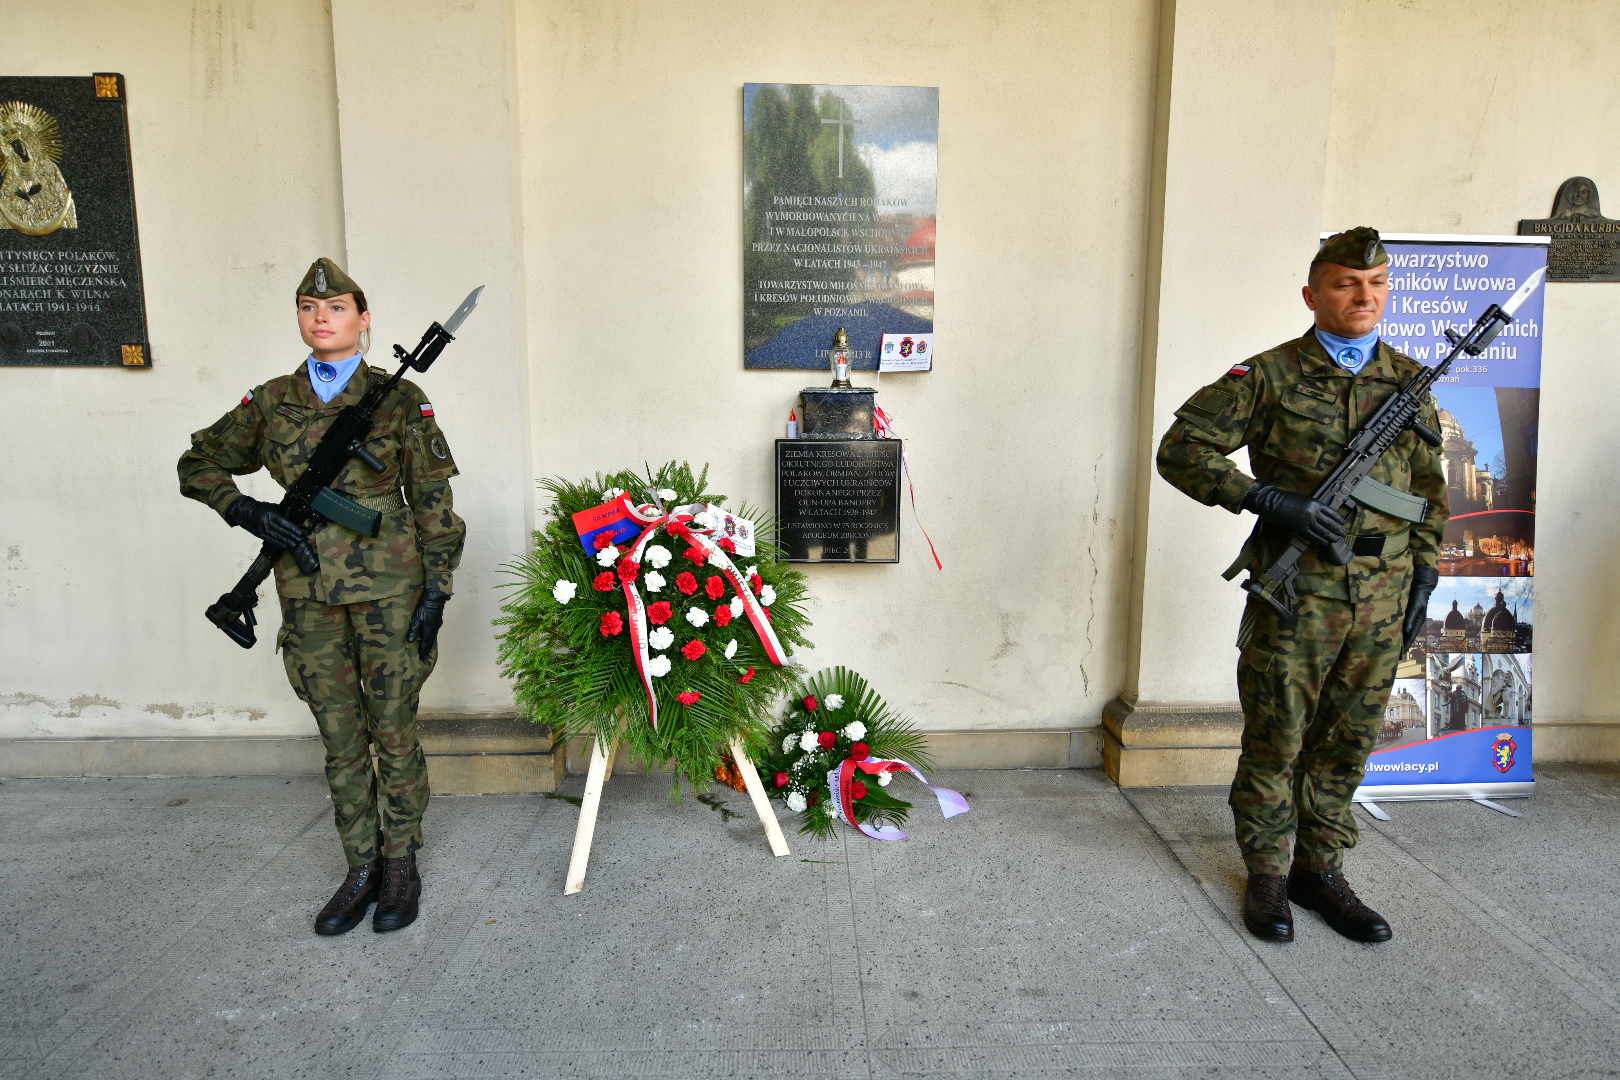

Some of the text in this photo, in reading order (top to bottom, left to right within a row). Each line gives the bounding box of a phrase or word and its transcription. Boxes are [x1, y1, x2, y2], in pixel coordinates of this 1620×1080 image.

[773, 196, 813, 208] PAMIĘCI
[814, 196, 858, 207] NASZYCH
[766, 211, 856, 222] WYMORDOWANYCH
[859, 212, 872, 222] NA
[775, 228, 785, 236] W
[786, 228, 850, 237] MAŁOPOLSCE
[1534, 223, 1581, 233] BRYGIDA
[752, 242, 783, 252] PRZEZ
[784, 242, 864, 253] NACJONALISTÓW
[5, 251, 55, 261] TYSIĘCY
[794, 258, 803, 268] W
[804, 258, 841, 268] LATACH
[1387, 252, 1489, 272] owarzystwo
[9, 262, 53, 274] SŁUŻĄC
[55, 263, 120, 274] OJCZYŹNIE
[10, 275, 53, 286] ŚMIERĆ
[56, 276, 127, 288] MĘCZEŃSKĄ
[758, 280, 828, 290] TOWARZYSTWO
[1388, 272, 1516, 291] śników Lwowa
[71, 289, 110, 299] WILNA
[754, 293, 758, 301] I
[758, 292, 798, 303] KRESÓW
[800, 293, 861, 303] POŁUDNIOWO
[47, 302, 101, 312] 1941-1944
[1392, 296, 1468, 314] i Kresów
[814, 308, 823, 316] W
[1377, 318, 1538, 338] niowo Wschnich
[1414, 346, 1430, 360] w
[1435, 342, 1517, 360] Pozaniu
[1455, 365, 1488, 375] pok.336
[1437, 374, 1460, 383] oznań
[785, 450, 814, 458] ZIEMIA
[815, 450, 855, 458] KRESOWA
[781, 458, 895, 469] OKRUTNEGO LUDOBÓJSTWA
[788, 479, 839, 487] UCZCIWYCH
[840, 478, 892, 487] UKRAIŃCÓW
[794, 489, 882, 497] DOKONANEGO PRZEZ
[592, 508, 621, 522] SEMPER
[1366, 761, 1439, 774] .lwowiacy.pl
